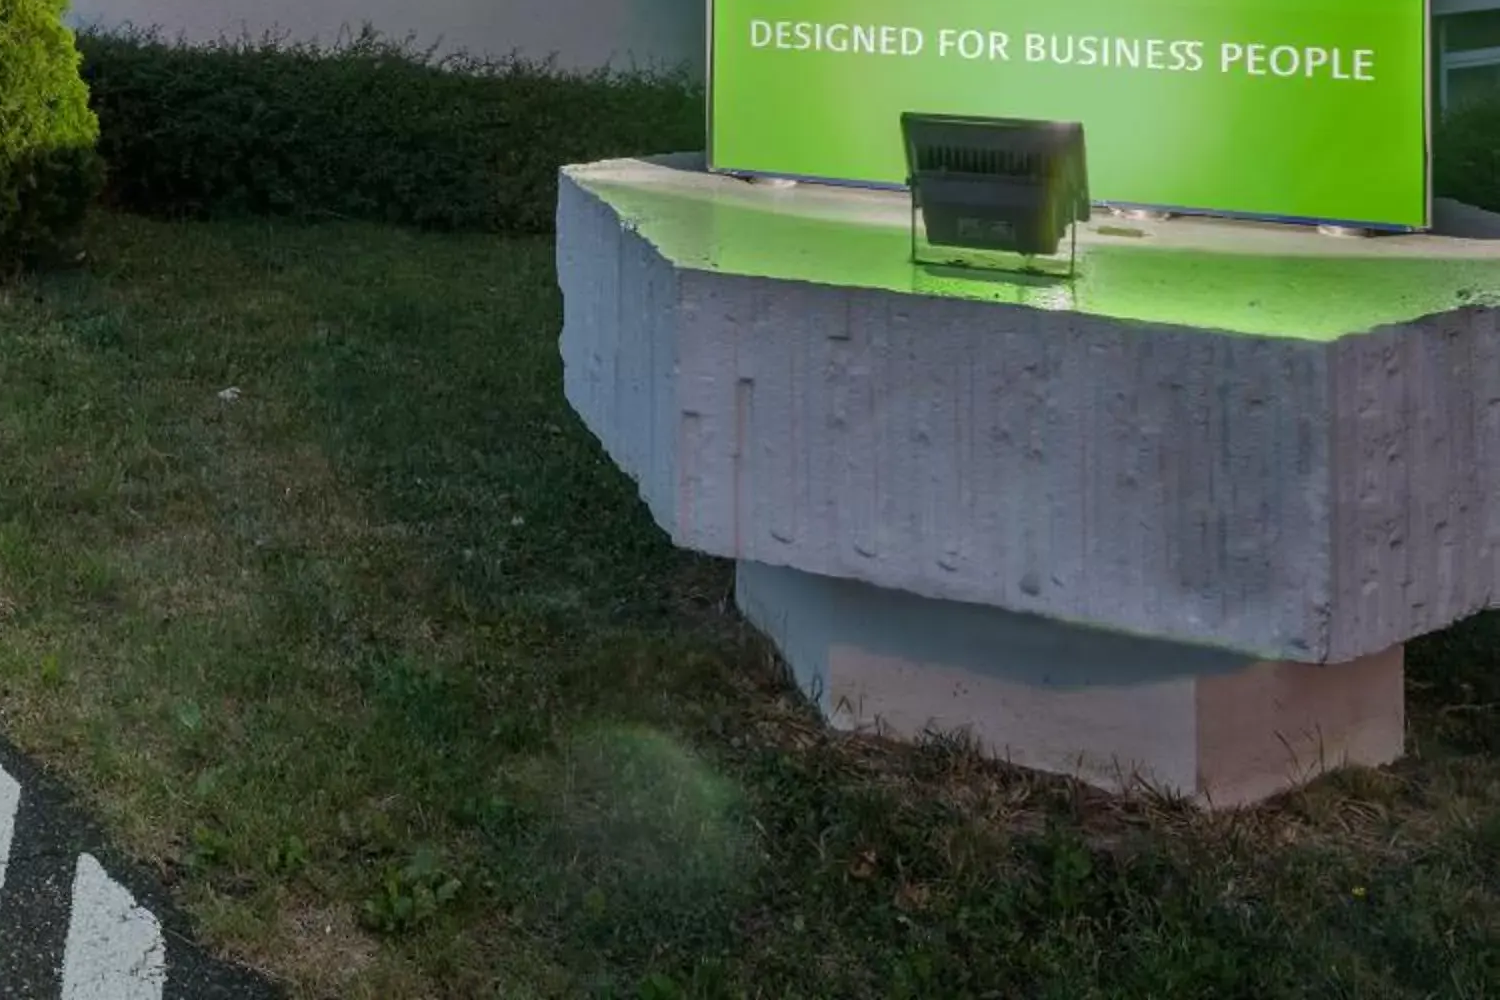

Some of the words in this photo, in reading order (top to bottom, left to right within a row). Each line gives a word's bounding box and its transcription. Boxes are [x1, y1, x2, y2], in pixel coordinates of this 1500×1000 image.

[750, 19, 925, 57] DESIGNED
[940, 31, 1010, 61] FOR
[1026, 34, 1204, 72] BUSINESS
[1219, 42, 1375, 81] PEOPLE
